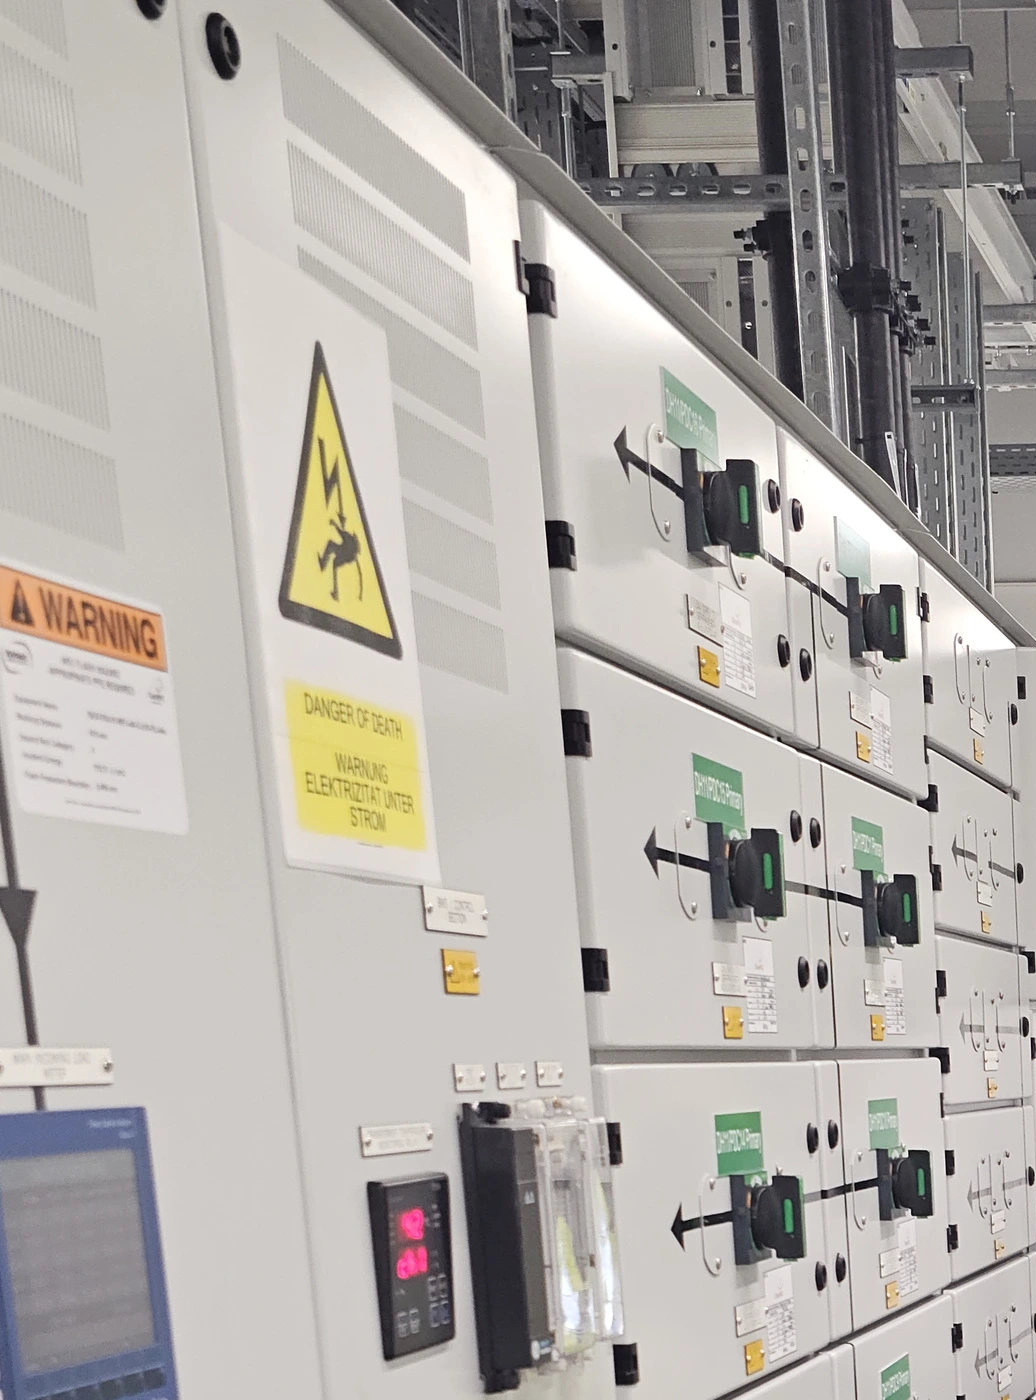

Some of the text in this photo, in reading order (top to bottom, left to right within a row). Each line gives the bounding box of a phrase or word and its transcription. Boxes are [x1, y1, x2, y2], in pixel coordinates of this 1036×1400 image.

[38, 586, 159, 660] WARNING
[303, 692, 404, 742] DANGER OF DEATH
[335, 751, 389, 784] WARNUNG
[305, 771, 415, 815] ELEKTRIZITAT UNTER
[350, 806, 388, 833] STROM
